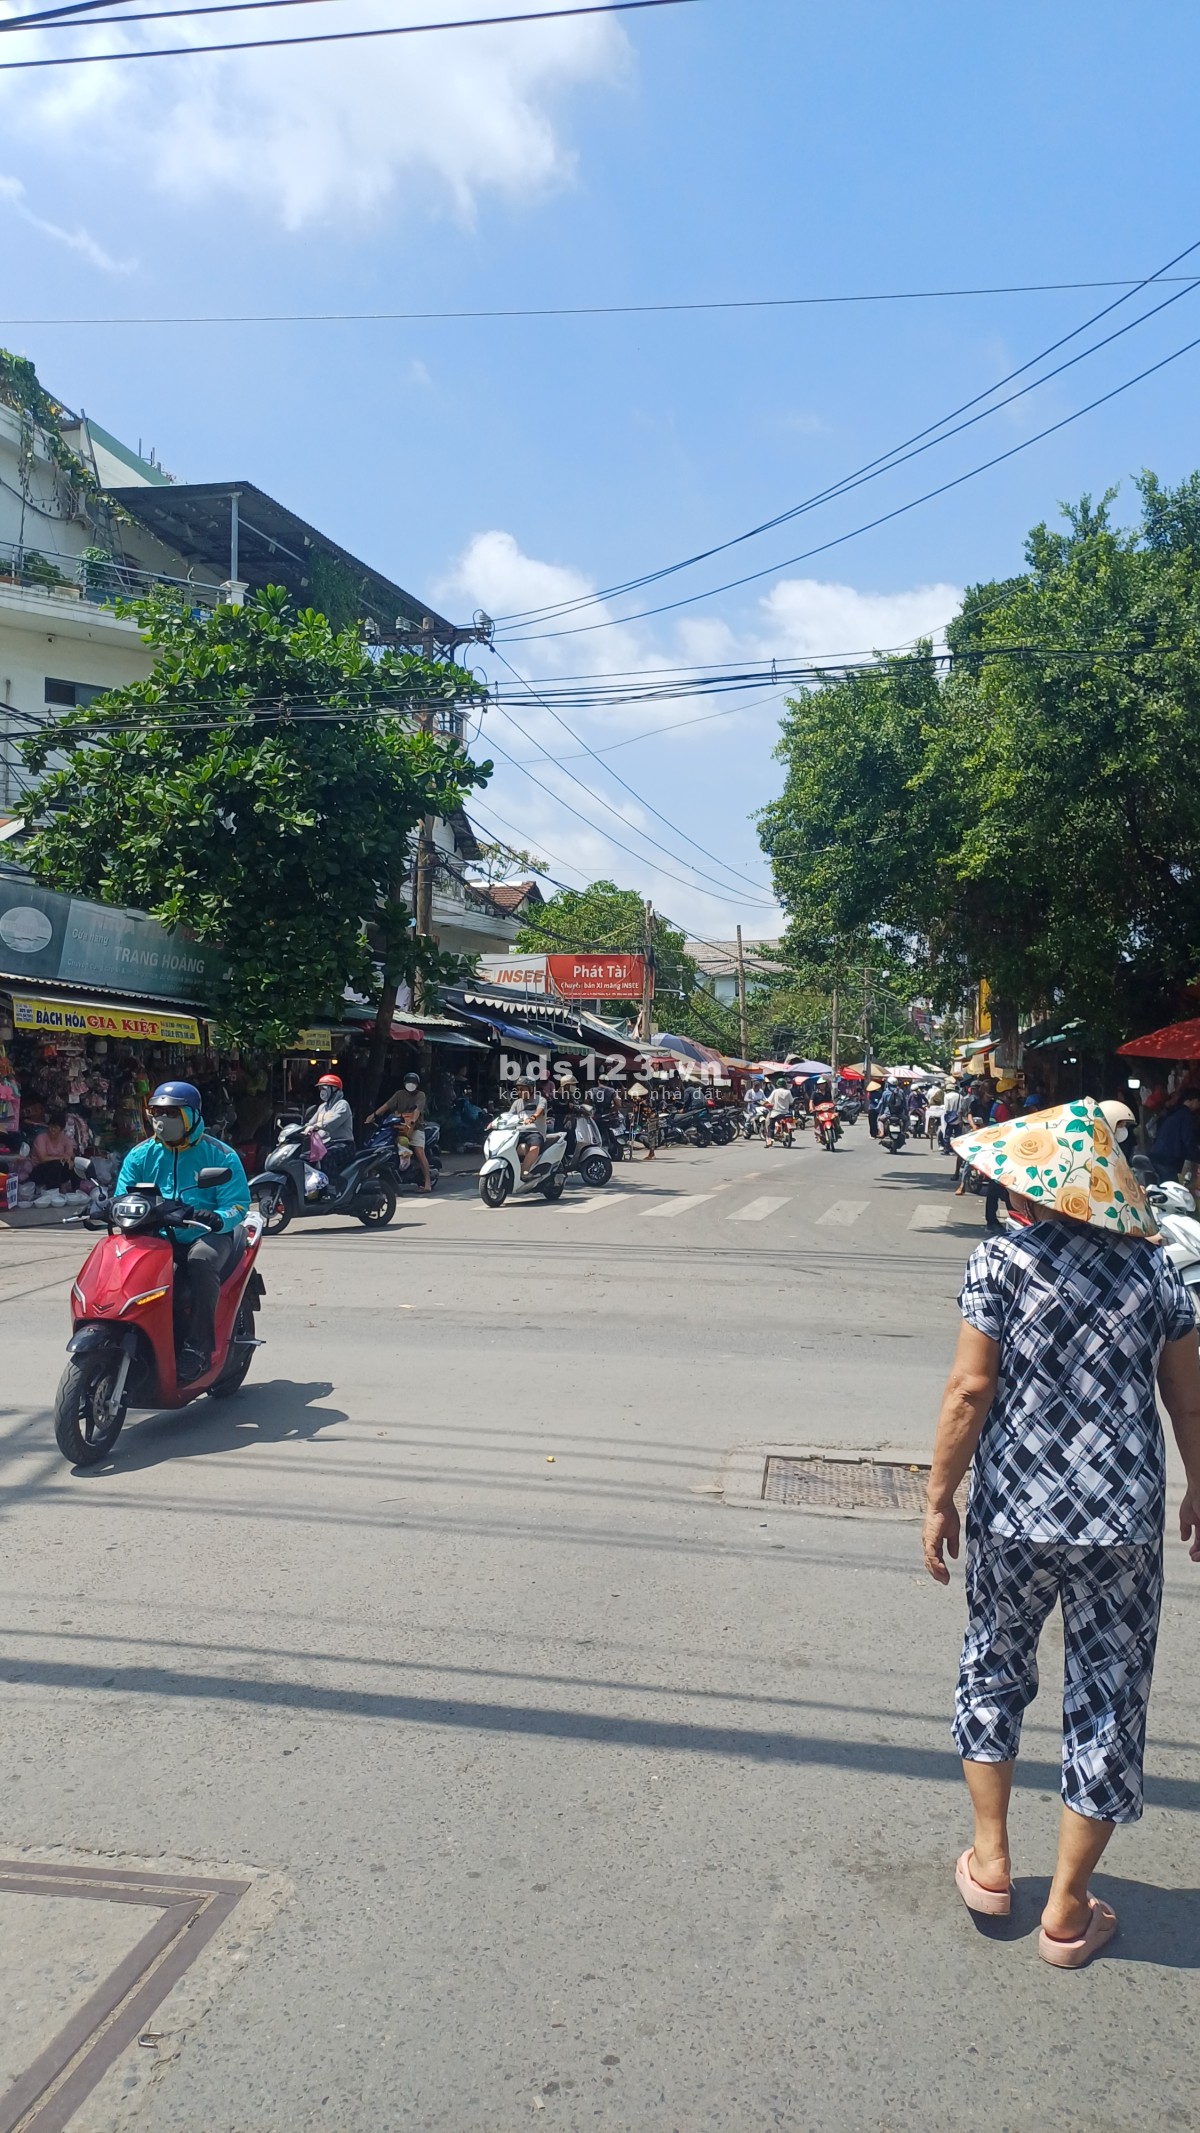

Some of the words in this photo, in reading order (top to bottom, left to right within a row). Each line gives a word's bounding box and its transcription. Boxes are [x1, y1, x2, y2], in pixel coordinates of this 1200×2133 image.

[114, 947, 158, 967] TRANG
[161, 952, 205, 974] HOÀNG
[496, 970, 544, 983] INSEE
[573, 965, 604, 978] Phát
[606, 965, 627, 978] Tài
[36, 1007, 62, 1027] BÁCH
[64, 1011, 87, 1028] HÓA
[86, 1015, 118, 1032] GIA
[121, 1017, 158, 1038] KIỆT
